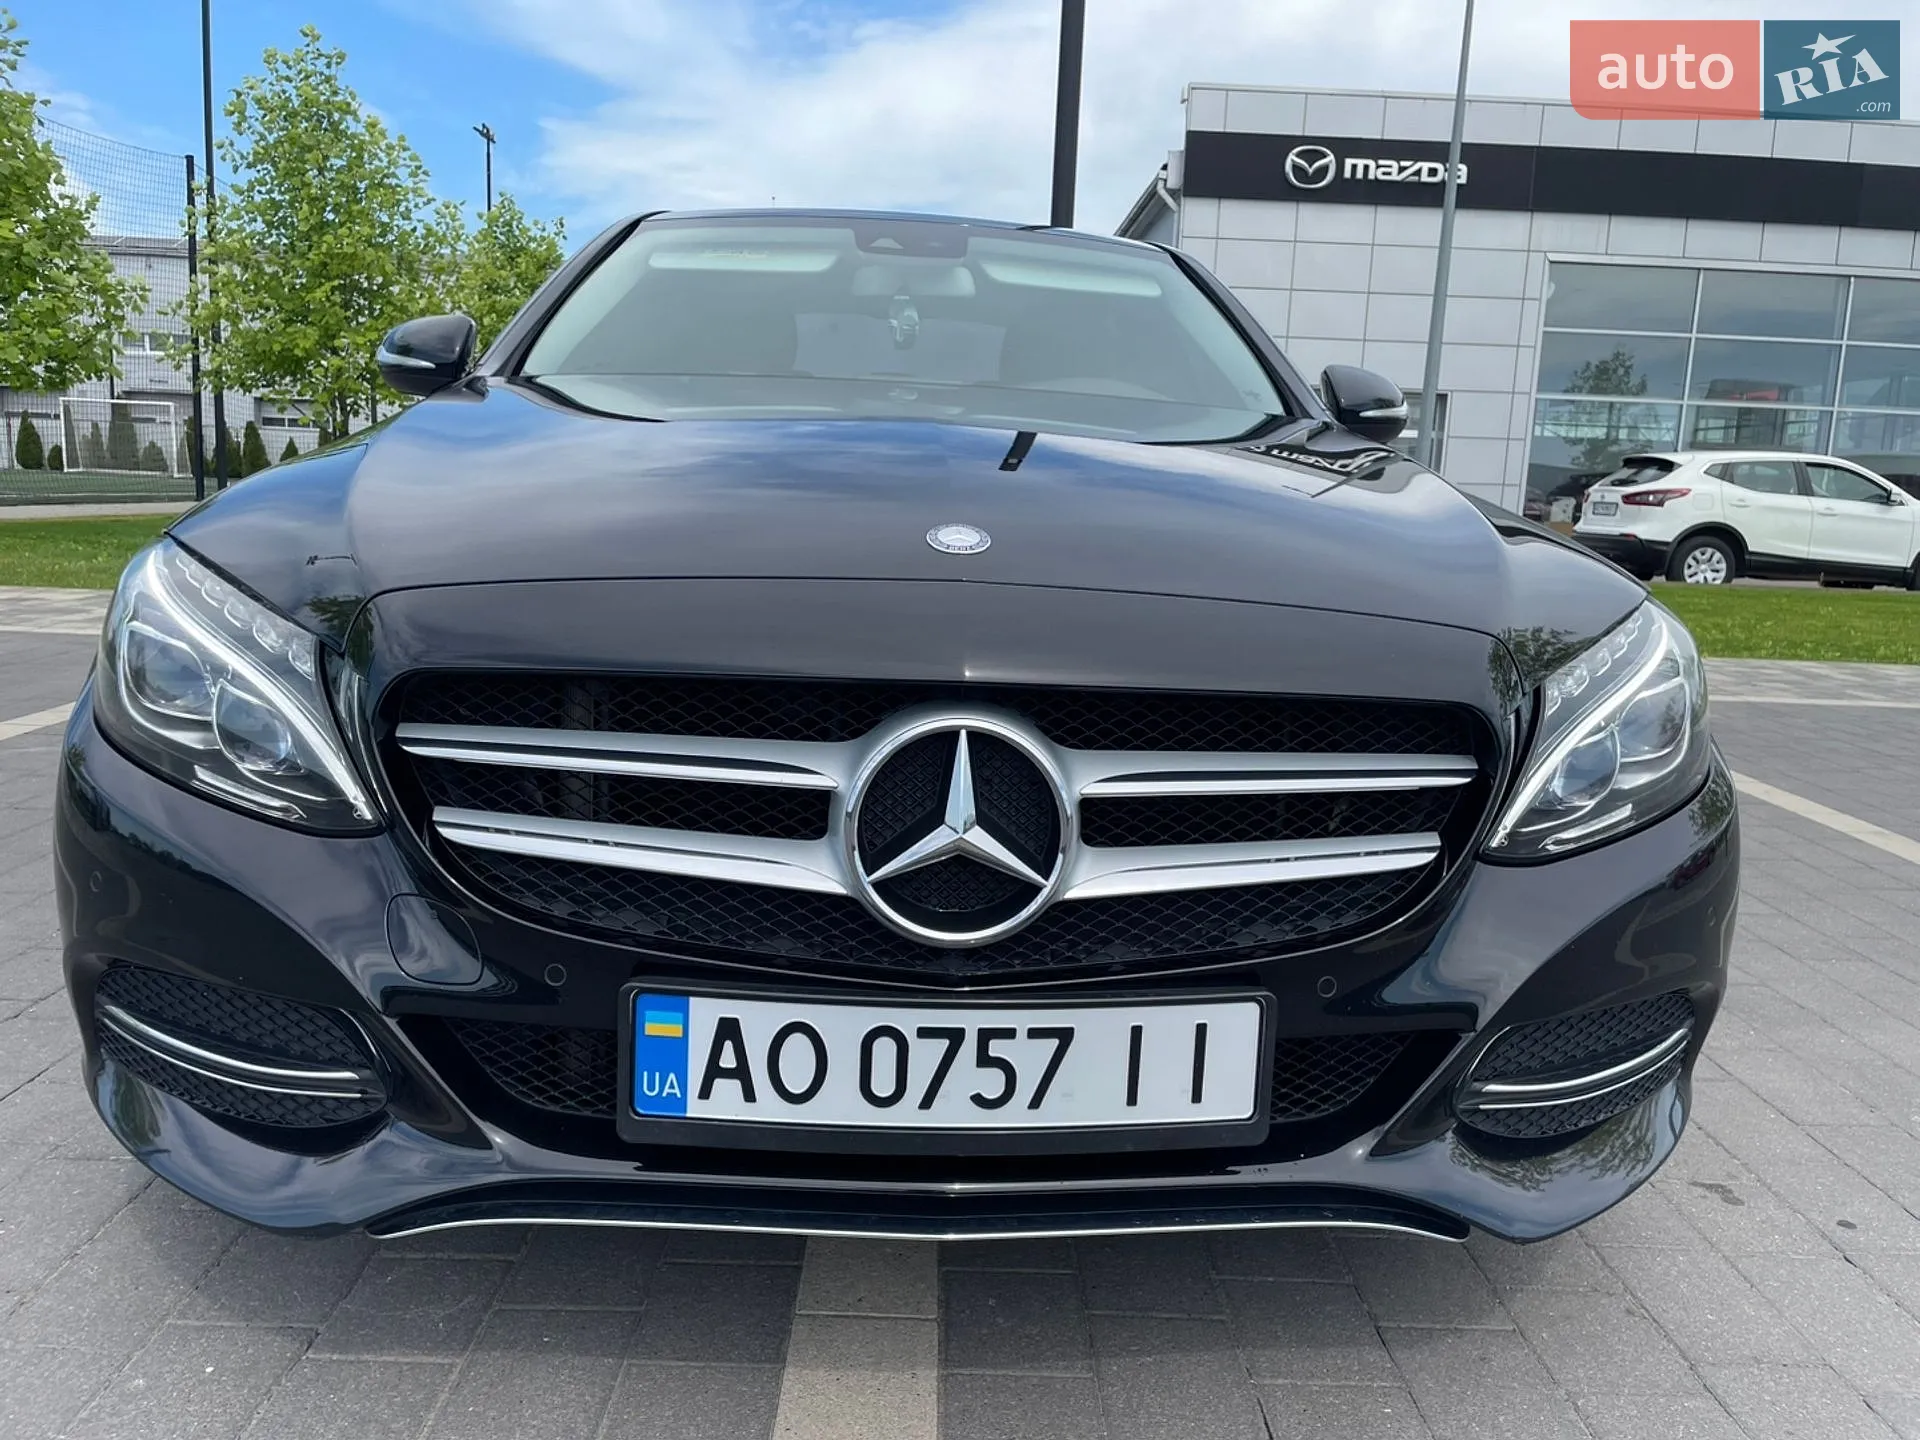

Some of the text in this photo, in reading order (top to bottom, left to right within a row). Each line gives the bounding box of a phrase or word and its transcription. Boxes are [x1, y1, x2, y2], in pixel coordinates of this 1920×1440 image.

[642, 1071, 681, 1098] UA
[697, 1016, 828, 1105] AO
[859, 1024, 1074, 1110] 0757
